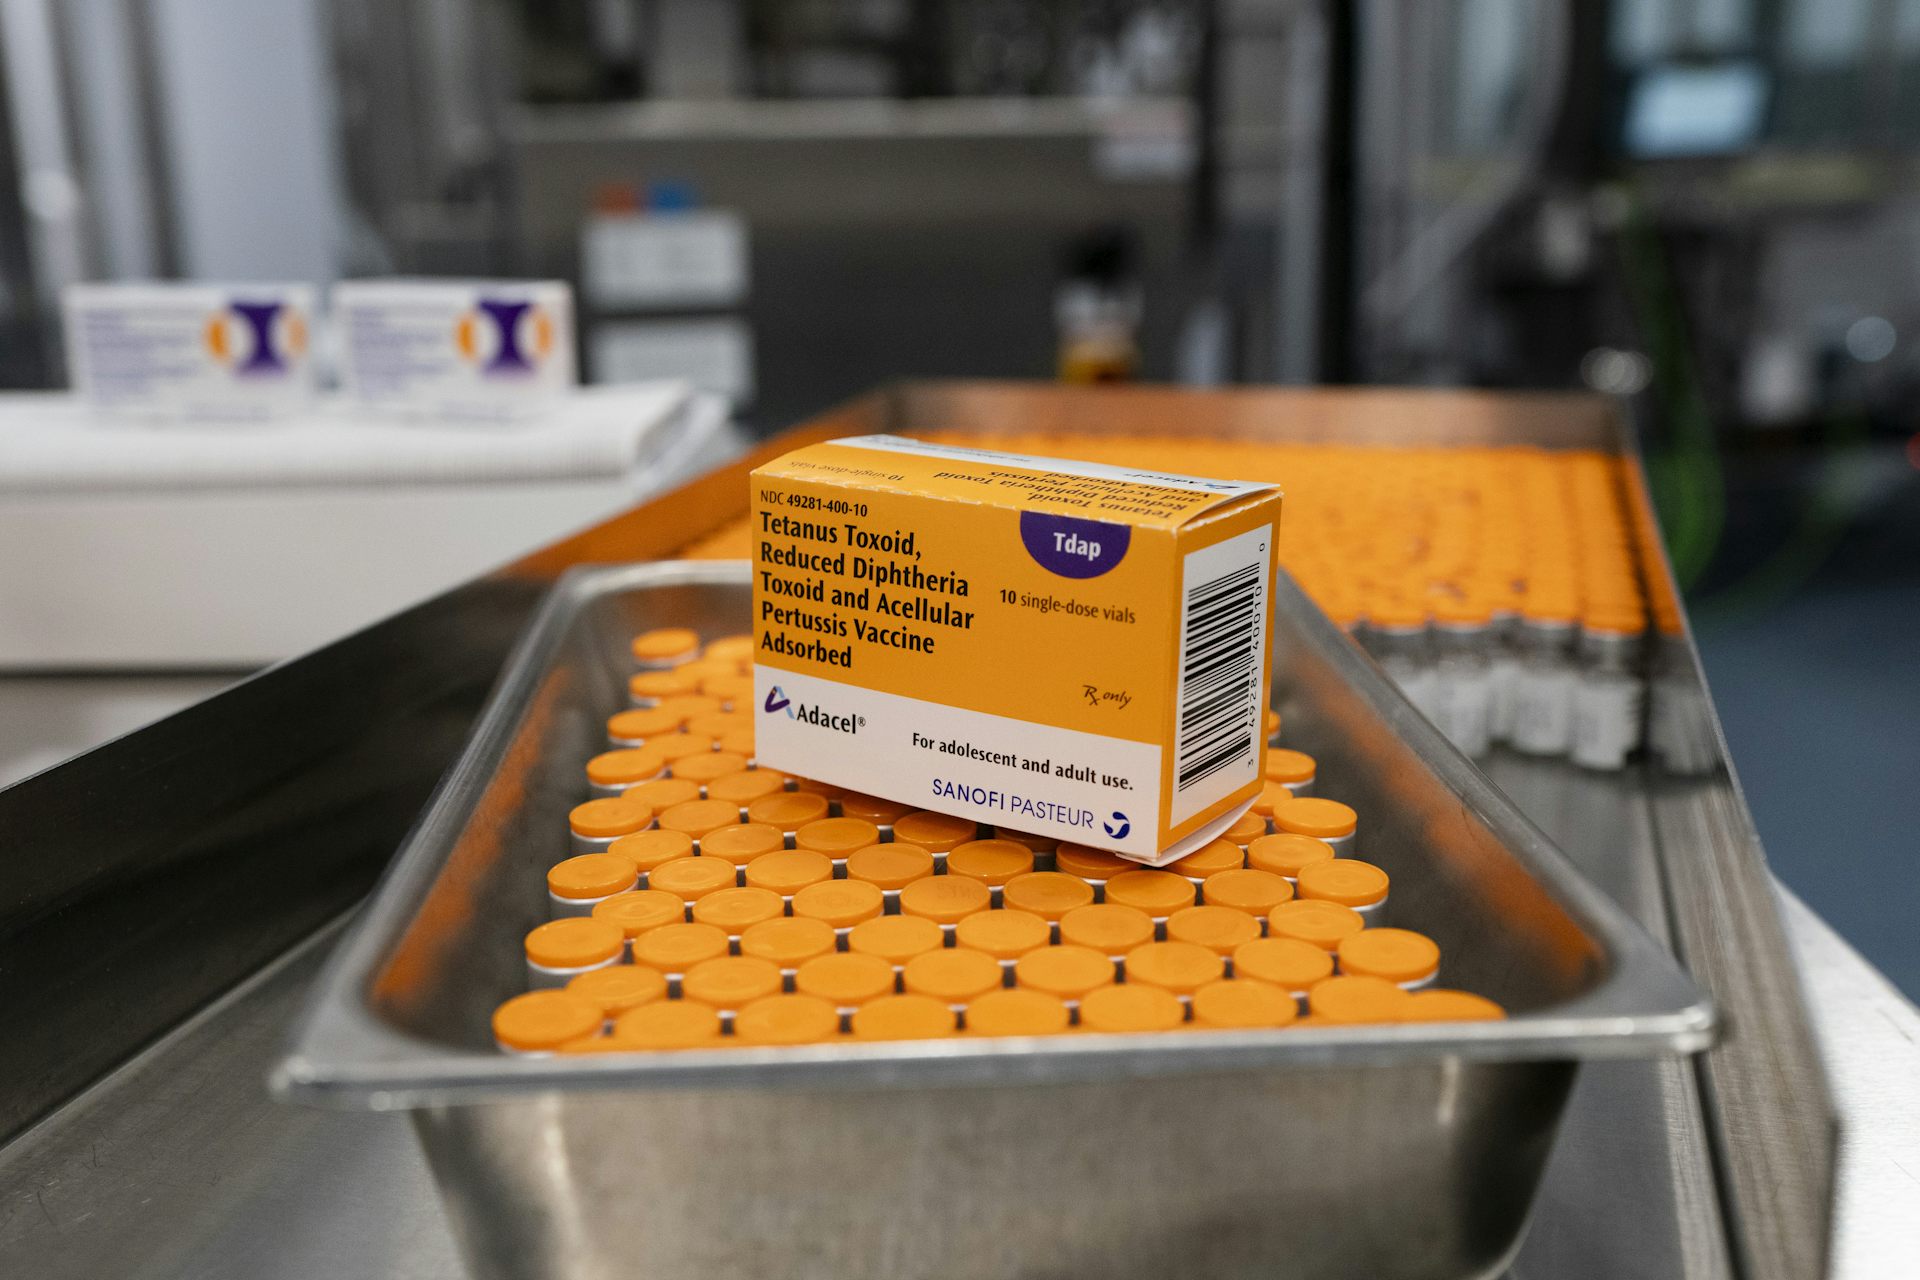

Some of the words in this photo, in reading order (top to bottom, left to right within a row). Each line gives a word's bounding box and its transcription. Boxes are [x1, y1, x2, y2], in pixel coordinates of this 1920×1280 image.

[933, 471, 996, 485] Toxoid
[988, 471, 1069, 487] Pertussis
[1000, 479, 1099, 500] Diphtheria
[1044, 472, 1133, 489] Adsorbed
[1072, 482, 1157, 498] Acellular
[760, 489, 784, 505] NDC
[786, 493, 868, 518] 49281-400-10
[1028, 492, 1092, 509] Toxoid,
[1100, 494, 1188, 512] Reduced
[1100, 503, 1173, 520] Tetanus
[760, 511, 838, 544] Tetanus
[844, 524, 921, 561] Toxoid,
[1053, 531, 1102, 562] Tdap
[761, 541, 845, 576] Reduced
[853, 557, 969, 597] Diphtheria
[760, 571, 824, 603] Toxoid
[831, 588, 869, 611] and
[876, 593, 975, 630] Acellular
[1000, 588, 1017, 605] 10
[1021, 592, 1099, 618] single-dose
[1103, 604, 1136, 625] vials
[761, 600, 848, 637] Pertussis
[854, 618, 936, 654] Vaccine
[761, 630, 852, 669] Adsorbed
[1102, 690, 1133, 710] only
[912, 732, 935, 751] For
[939, 739, 1017, 769] adolescent
[1021, 756, 1050, 775] and
[1055, 764, 1097, 784] adult
[1102, 774, 1134, 791] use.
[932, 778, 1004, 810] SANOFI
[1011, 795, 1094, 829] PASTEUR
